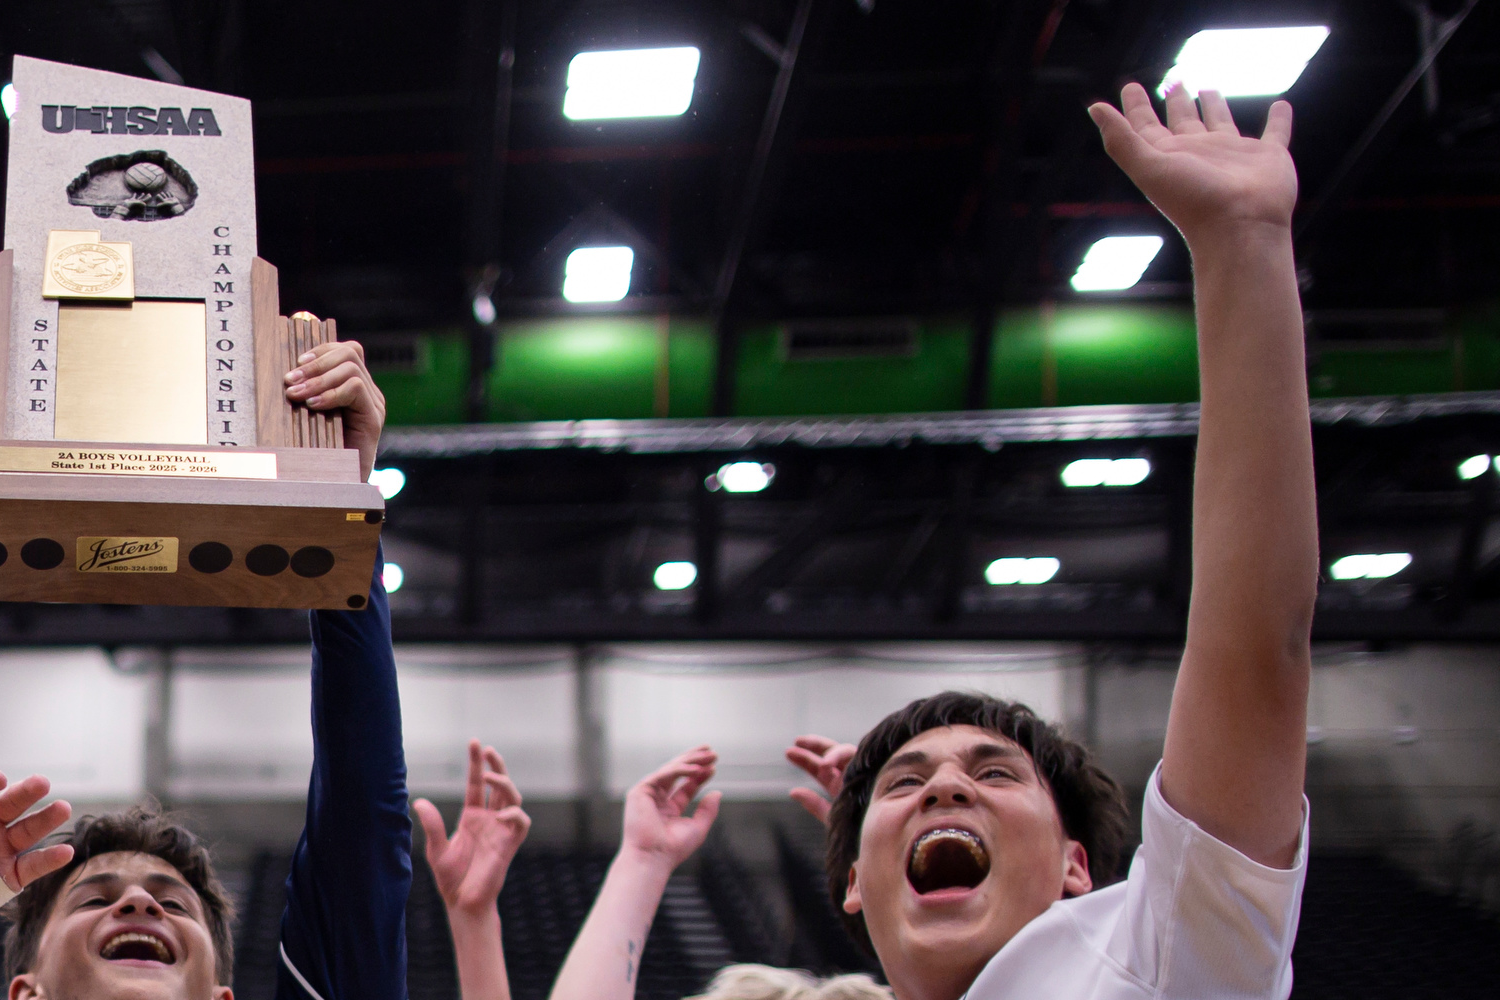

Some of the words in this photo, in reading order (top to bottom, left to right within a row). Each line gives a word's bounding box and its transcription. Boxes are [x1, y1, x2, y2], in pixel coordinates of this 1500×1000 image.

[41, 105, 222, 136] UHSAA
[29, 319, 49, 412] STATE
[51, 461, 85, 469] State
[89, 462, 106, 470] 1st
[111, 463, 146, 471] Place
[149, 464, 177, 472] 2025
[189, 465, 218, 473] 2026
[58, 452, 75, 460] 2A
[79, 453, 115, 461] BOYS
[118, 454, 211, 463] VOLLEYBALL
[79, 539, 164, 571] Jostens
